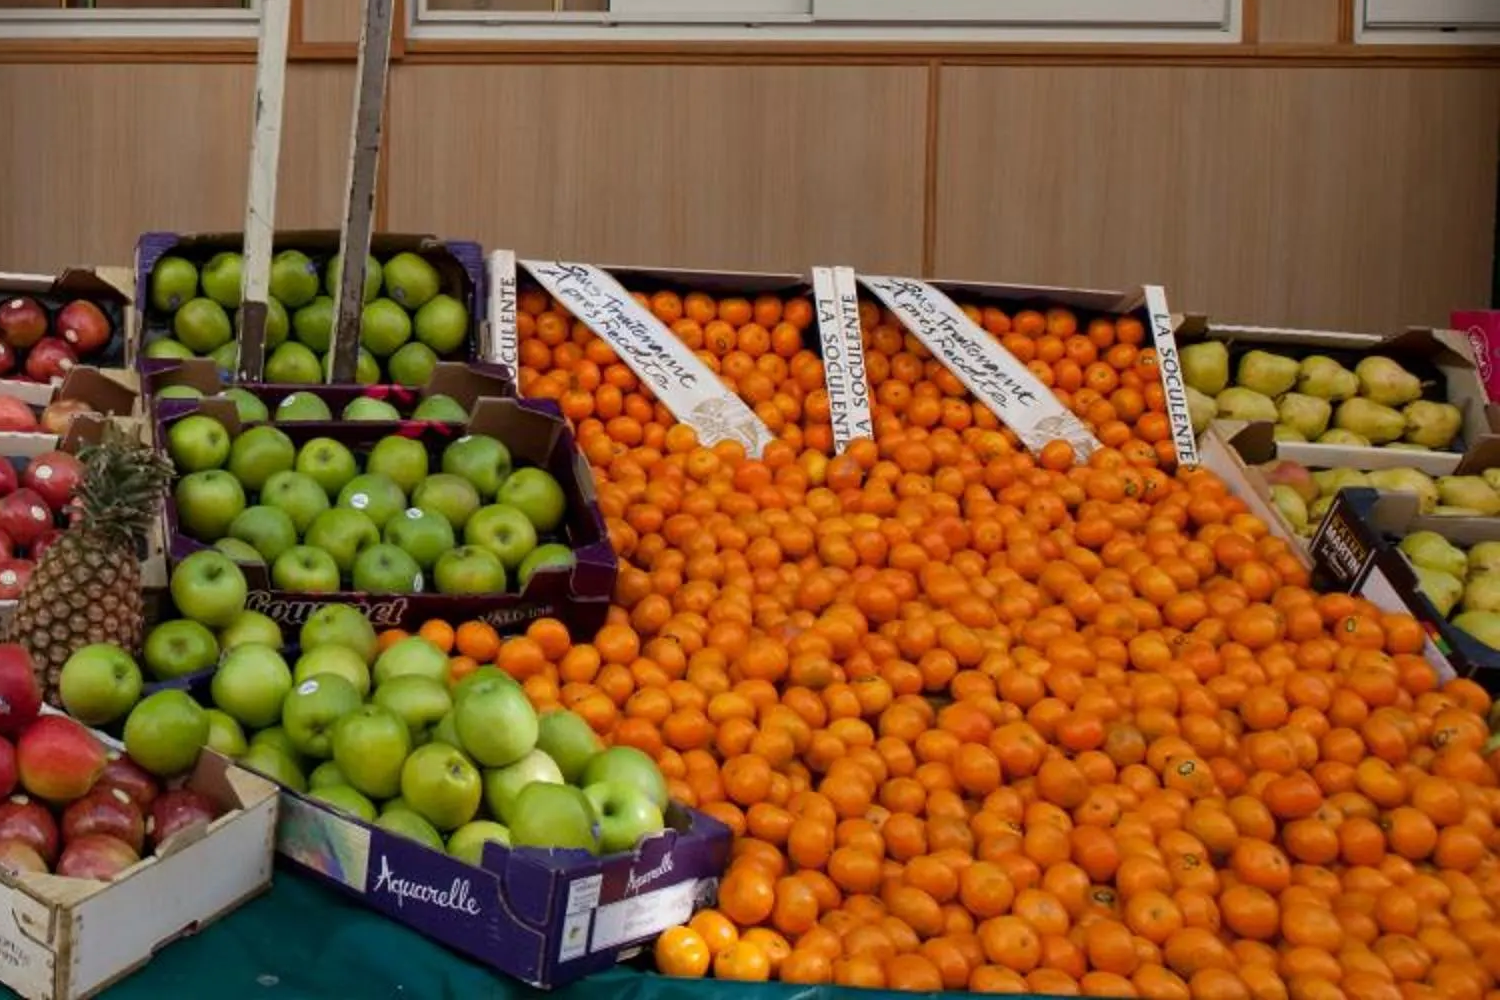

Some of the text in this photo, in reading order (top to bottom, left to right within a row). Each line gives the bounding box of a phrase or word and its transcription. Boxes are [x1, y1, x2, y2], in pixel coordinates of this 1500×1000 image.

[819, 299, 850, 451] LA SOCULENTE
[841, 294, 872, 440] A SOCULENTE
[1153, 313, 1195, 462] LA SOCULENTE
[373, 855, 481, 916] Aquarelle
